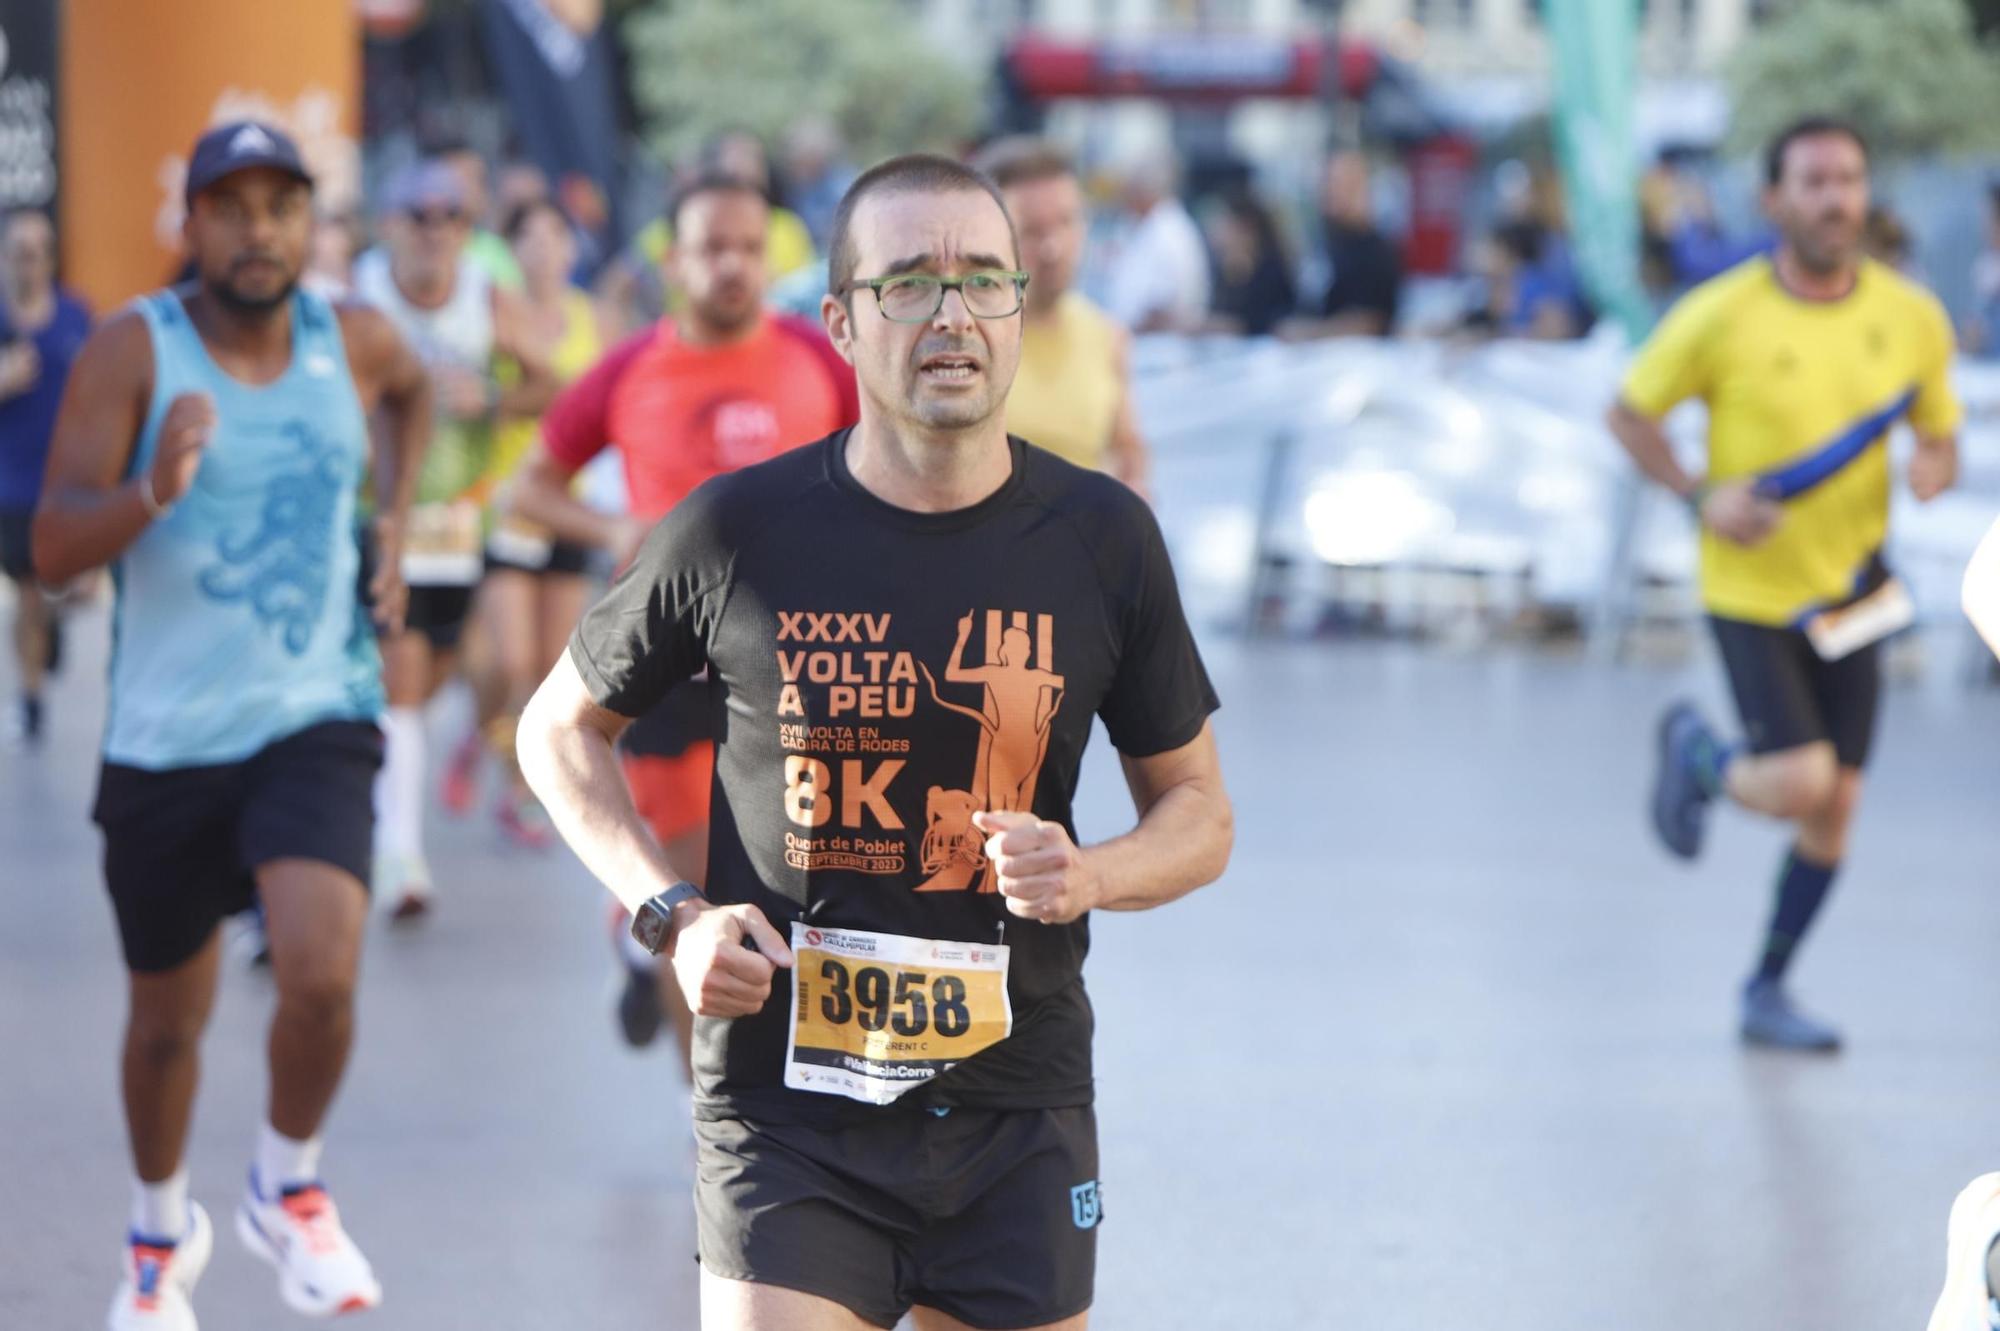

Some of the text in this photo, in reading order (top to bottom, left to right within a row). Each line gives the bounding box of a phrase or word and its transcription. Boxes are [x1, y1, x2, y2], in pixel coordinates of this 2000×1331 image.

[776, 611, 891, 642] XXXV
[776, 651, 918, 683] VOLTA
[777, 684, 917, 718] A PEU
[780, 723, 879, 739] XVII VOLTA EN
[780, 735, 910, 752] CADIRA DE RODES
[784, 755, 907, 830] 8K
[785, 832, 905, 854] Quart de Poblet
[803, 855, 868, 869] SEPTIEMBRE
[872, 860, 897, 870] 2023
[821, 959, 970, 1038] 3958
